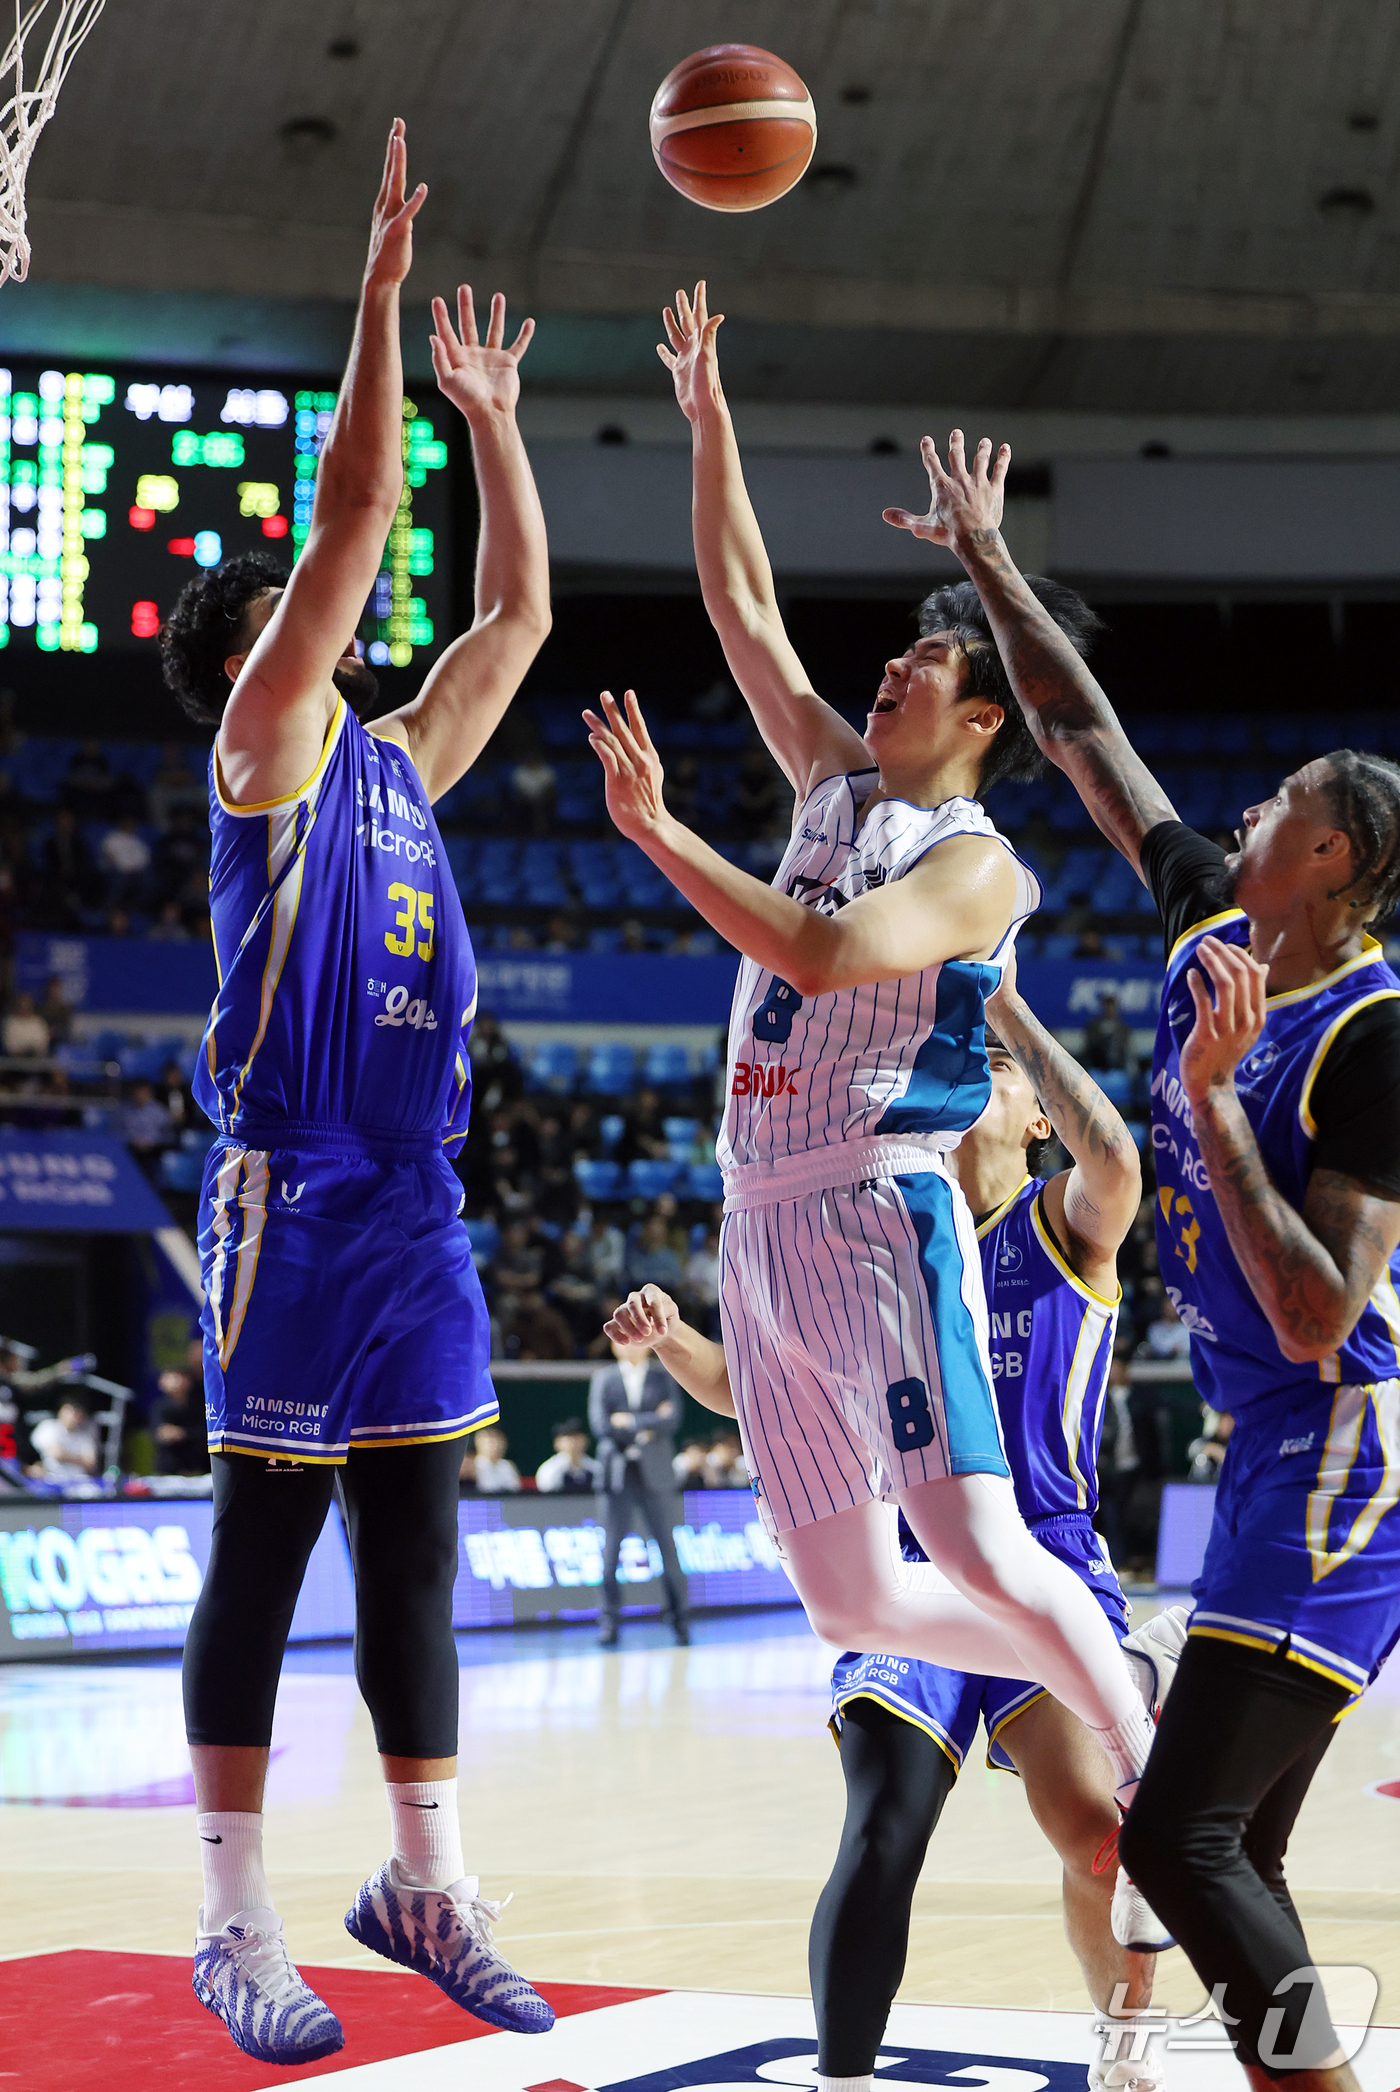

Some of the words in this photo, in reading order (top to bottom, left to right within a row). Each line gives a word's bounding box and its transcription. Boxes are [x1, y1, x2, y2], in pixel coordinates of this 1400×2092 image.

[384, 881, 435, 962] 35
[752, 974, 803, 1044] 8
[731, 1062, 802, 1098] BNK
[246, 1395, 329, 1418] SAMSUNG
[886, 1376, 935, 1453] 8
[242, 1413, 285, 1432] Micro
[289, 1420, 321, 1436] RGB
[845, 1654, 910, 1683] SAMSUNG
[868, 1667, 899, 1686] RGB
